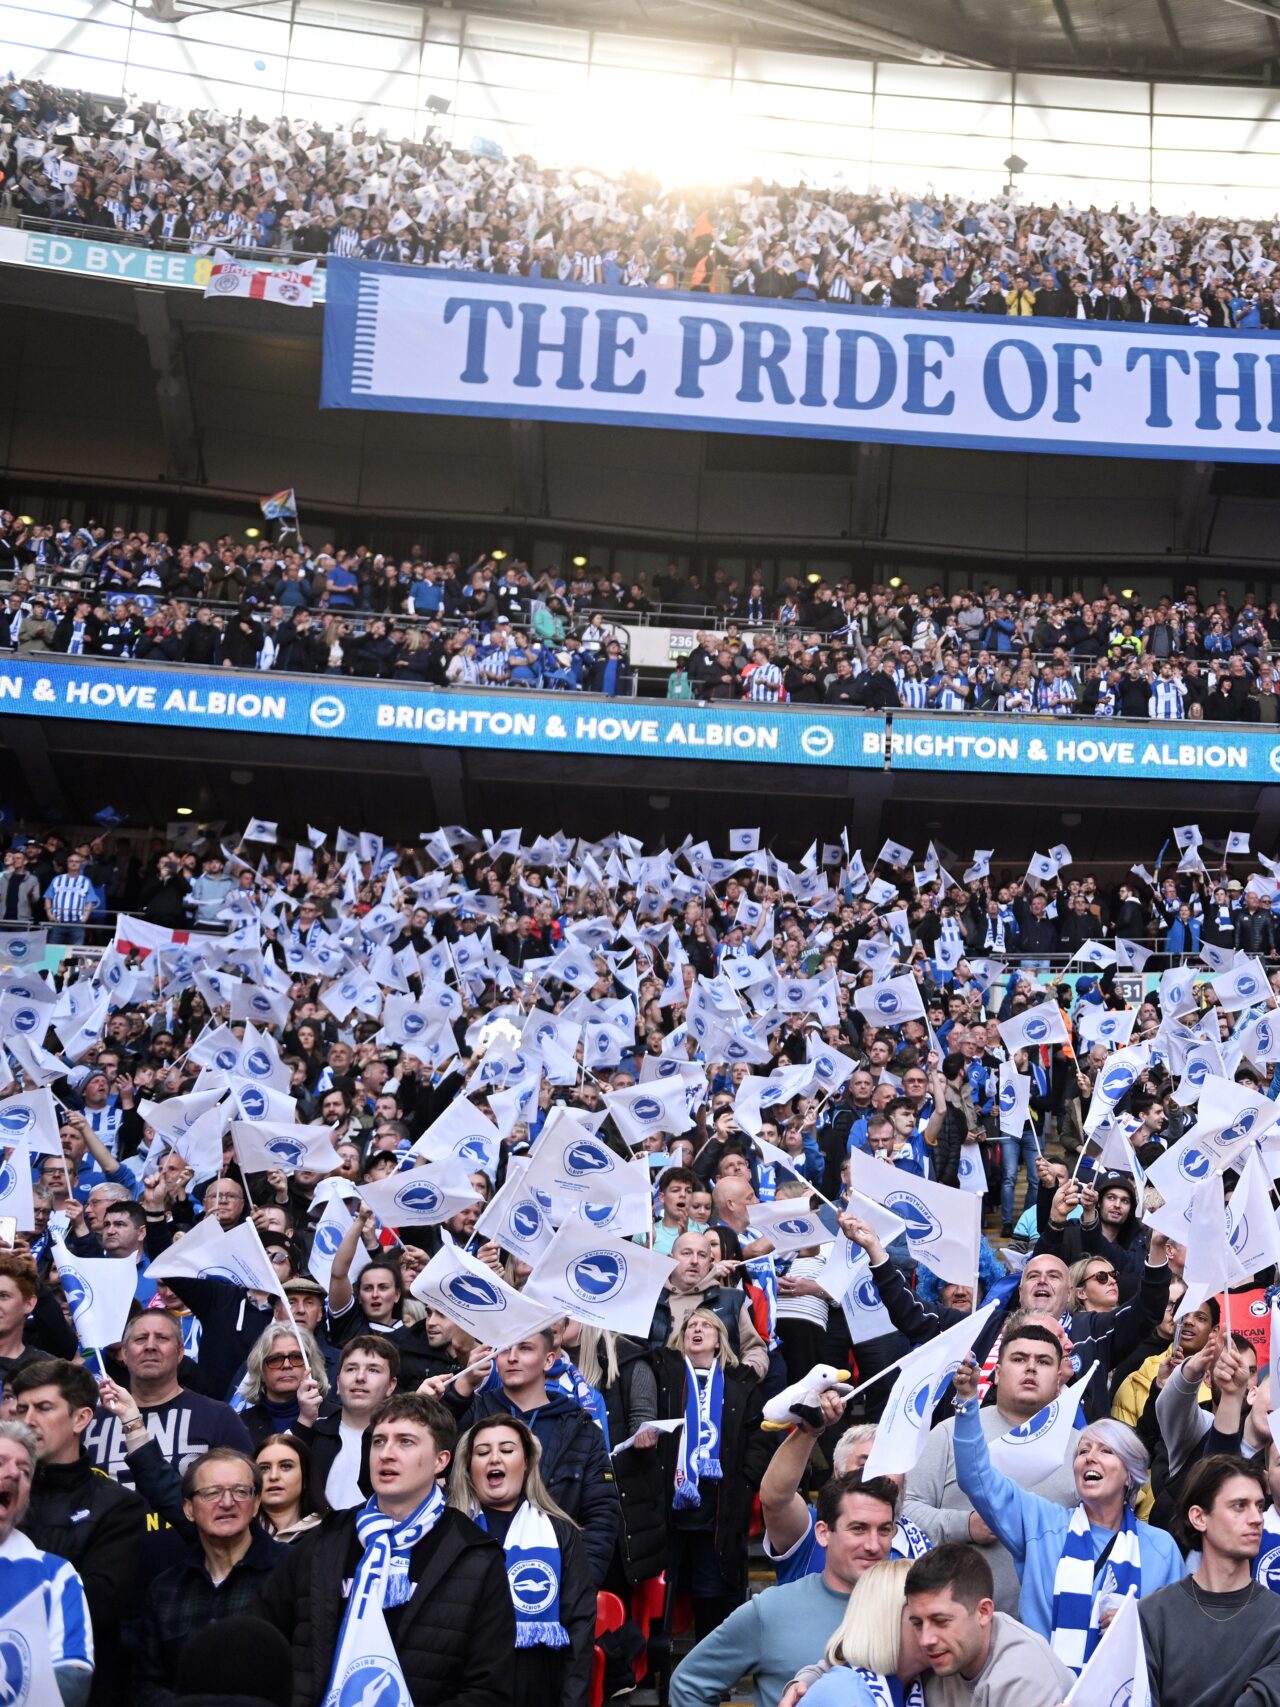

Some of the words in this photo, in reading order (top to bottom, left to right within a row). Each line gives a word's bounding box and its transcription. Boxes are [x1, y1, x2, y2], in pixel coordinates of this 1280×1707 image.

[27, 238, 72, 263] ED
[85, 246, 137, 273] BY
[144, 255, 188, 281] EE
[443, 297, 648, 395] THE
[675, 315, 955, 416] PRIDE
[983, 338, 1103, 424] OF
[670, 636, 692, 647] 236
[33, 679, 56, 702] &
[67, 682, 157, 710] HOVE
[164, 690, 287, 720] ALBION
[377, 705, 537, 737] BRIGHTON
[545, 715, 568, 739] &
[576, 717, 659, 743] HOVE
[666, 722, 779, 750] ALBION
[863, 732, 1018, 760] BRIGHTON
[1028, 739, 1048, 762] &
[1056, 740, 1134, 764] HOVE
[1141, 744, 1248, 769] ALBION
[1122, 984, 1141, 998] 31
[584, 1251, 614, 1259] BRIGHTON
[575, 1288, 597, 1301] ALBION
